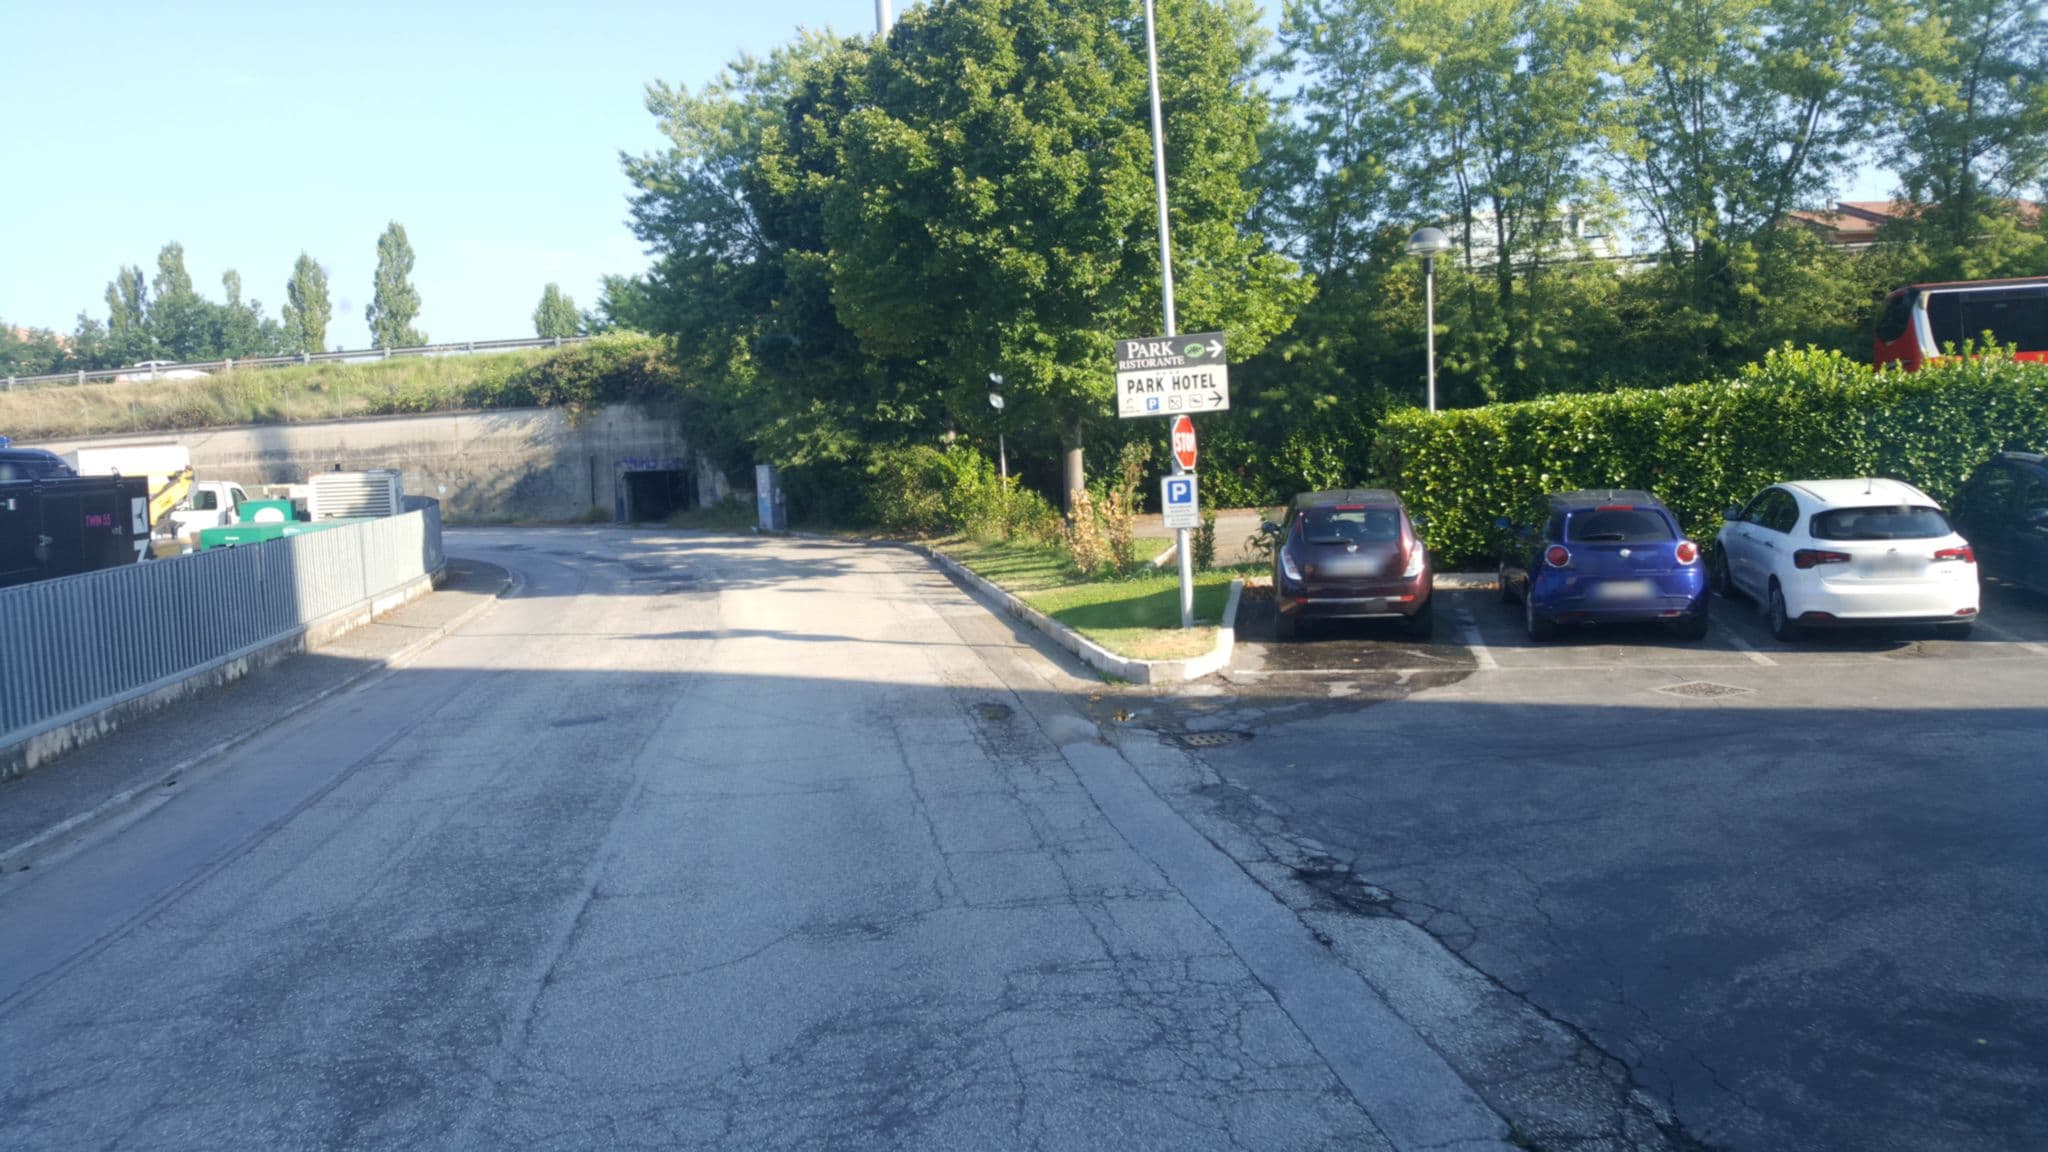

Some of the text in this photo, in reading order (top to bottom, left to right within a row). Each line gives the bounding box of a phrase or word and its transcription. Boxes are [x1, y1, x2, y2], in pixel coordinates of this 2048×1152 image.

[1127, 341, 1174, 358] PARK
[1119, 355, 1184, 370] RISTORANTE
[1127, 373, 1216, 394] PARK HOTEL
[1175, 432, 1196, 452] STOP
[1172, 483, 1187, 501] P
